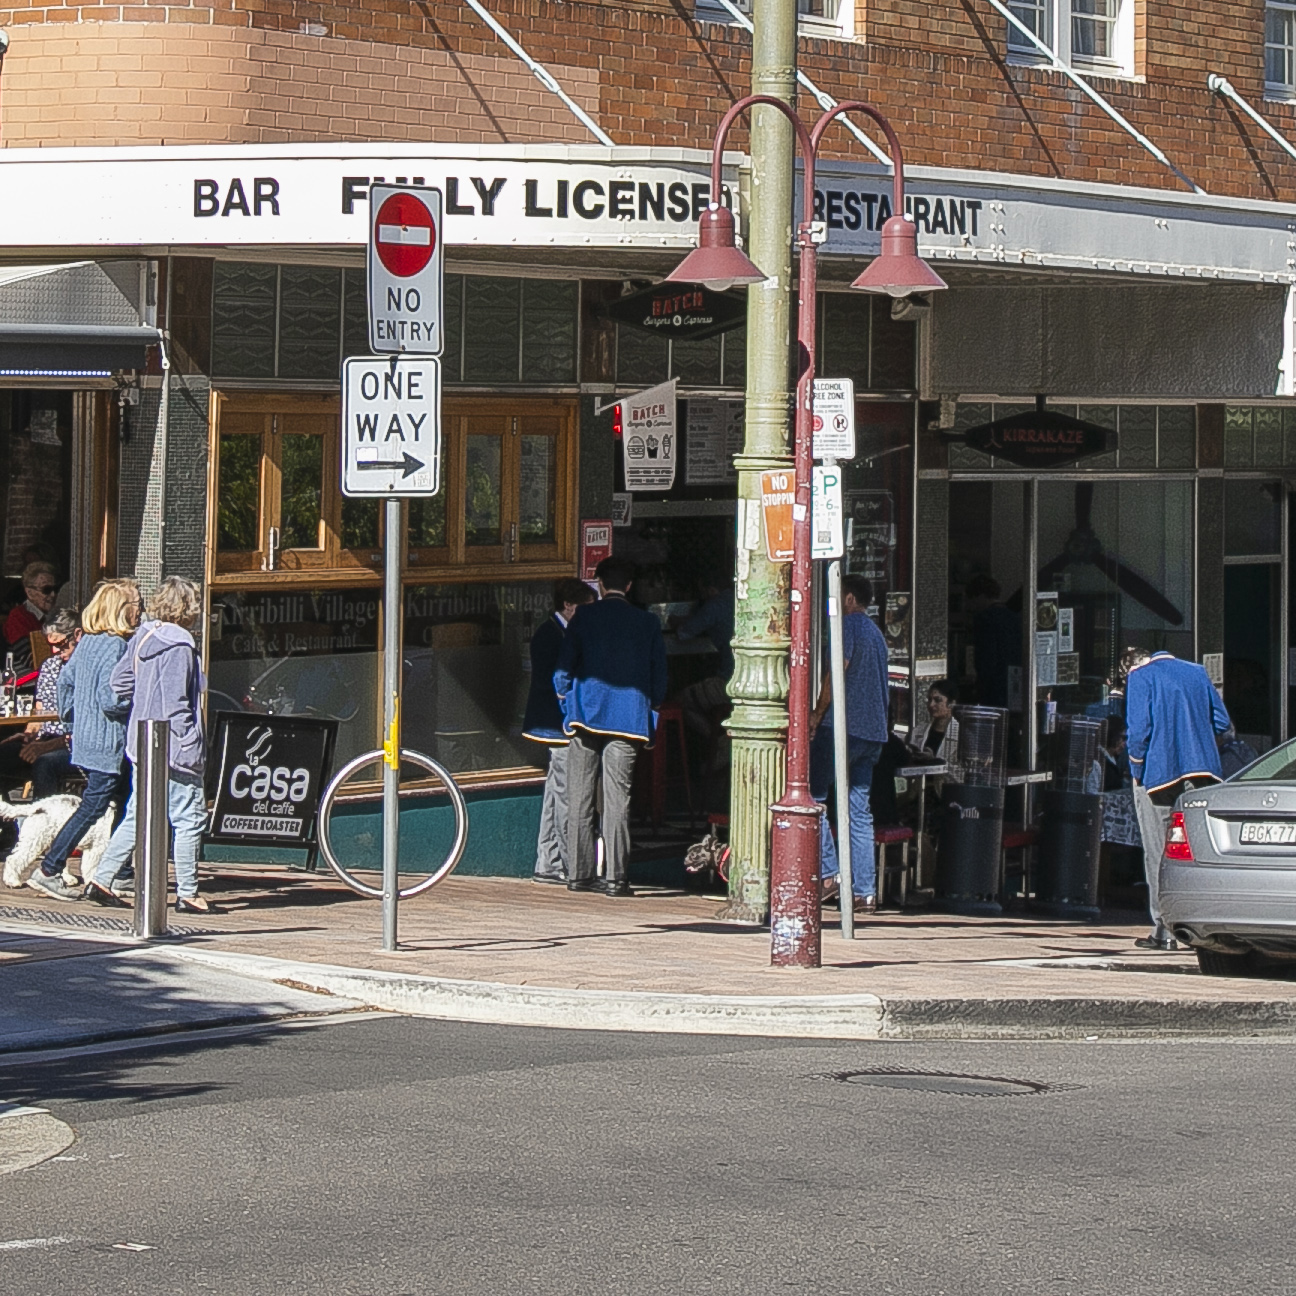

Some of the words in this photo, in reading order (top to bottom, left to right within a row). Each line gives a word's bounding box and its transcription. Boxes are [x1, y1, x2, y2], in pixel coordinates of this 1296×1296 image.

[193, 177, 281, 217] BAR
[341, 176, 507, 216] FLY
[387, 286, 421, 313] NO
[376, 319, 435, 342] ENTRY
[360, 371, 424, 401] ONE
[827, 391, 845, 400] ZONE
[632, 404, 666, 421] BATCH
[355, 412, 428, 443] WAY
[1003, 428, 1084, 444] KIRRAKAZE
[771, 475, 789, 491] NO
[222, 595, 304, 627] Kirribilli
[310, 595, 377, 628] Village
[230, 764, 310, 802] casa
[252, 800, 269, 814] del
[223, 816, 260, 830] COFFEE
[260, 818, 301, 833] ROASTER
